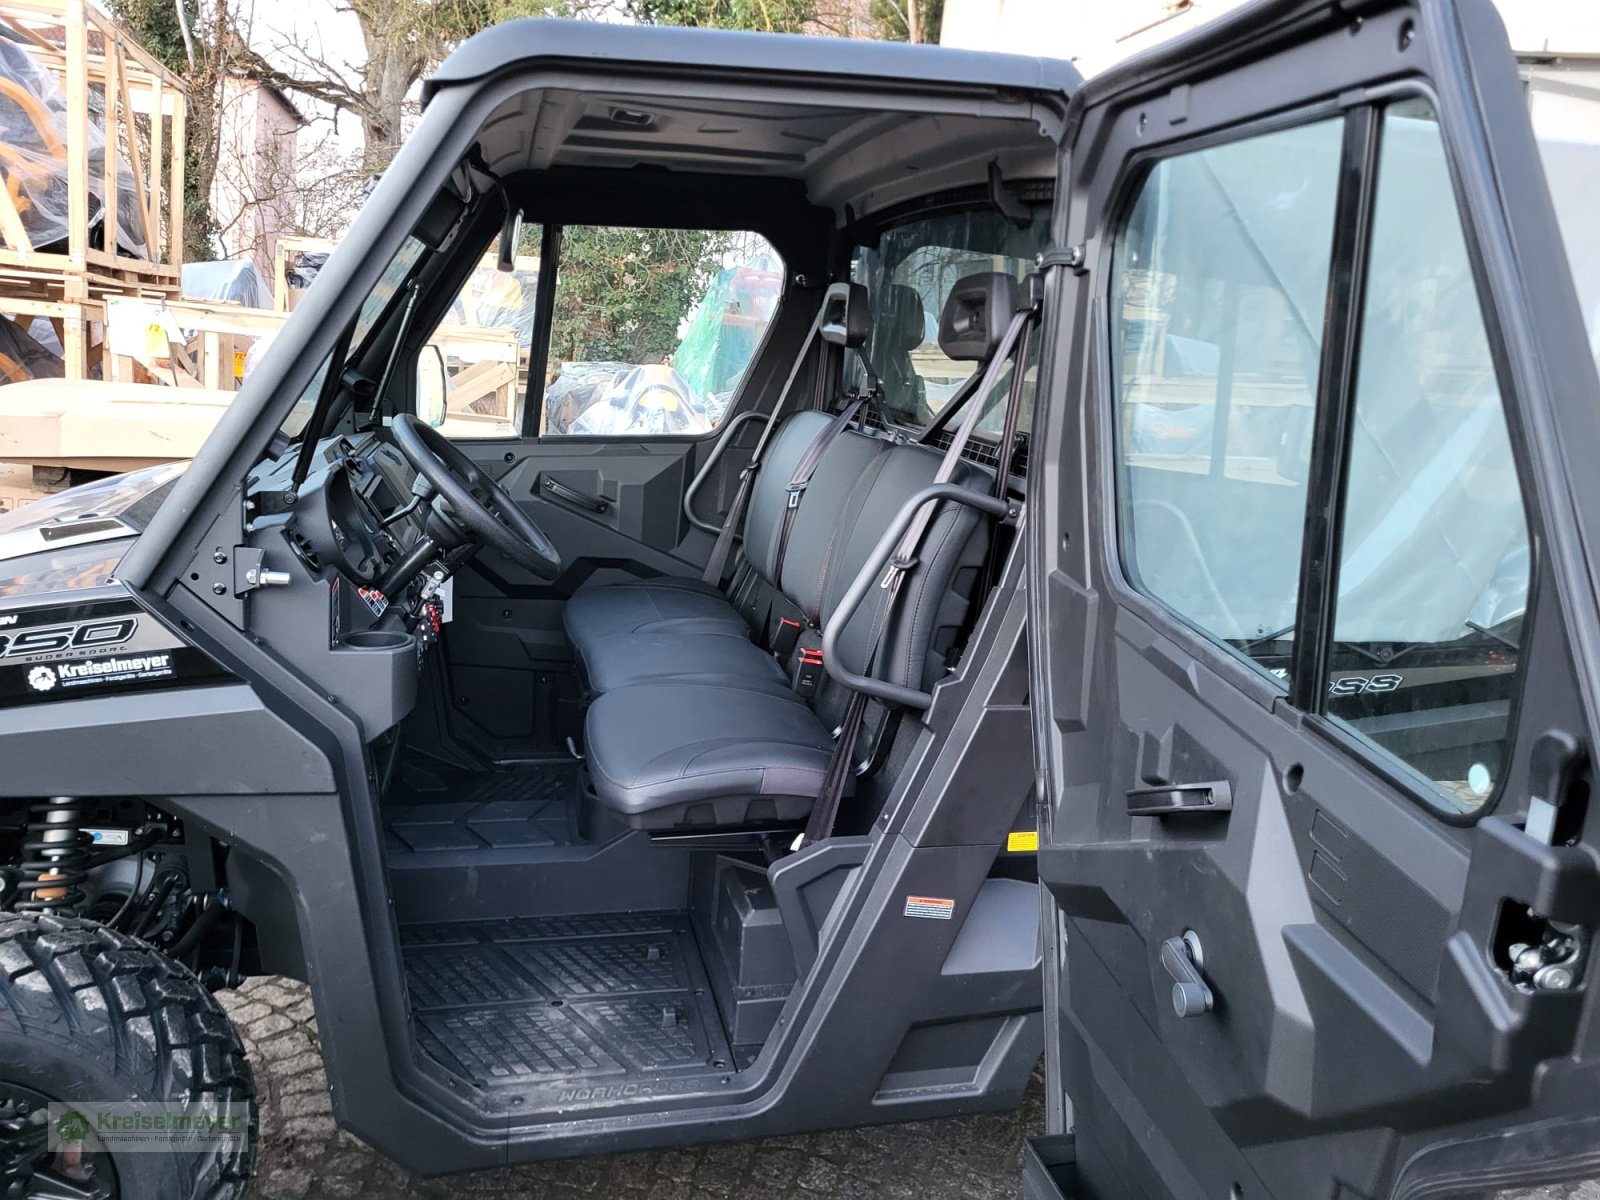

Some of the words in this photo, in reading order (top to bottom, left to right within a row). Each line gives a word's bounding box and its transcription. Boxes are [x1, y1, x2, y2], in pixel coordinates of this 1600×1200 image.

[0, 617, 138, 658] 50
[25, 652, 74, 662] SUPER
[78, 646, 128, 656] SPORT
[57, 654, 170, 680] Kreiselmeyer
